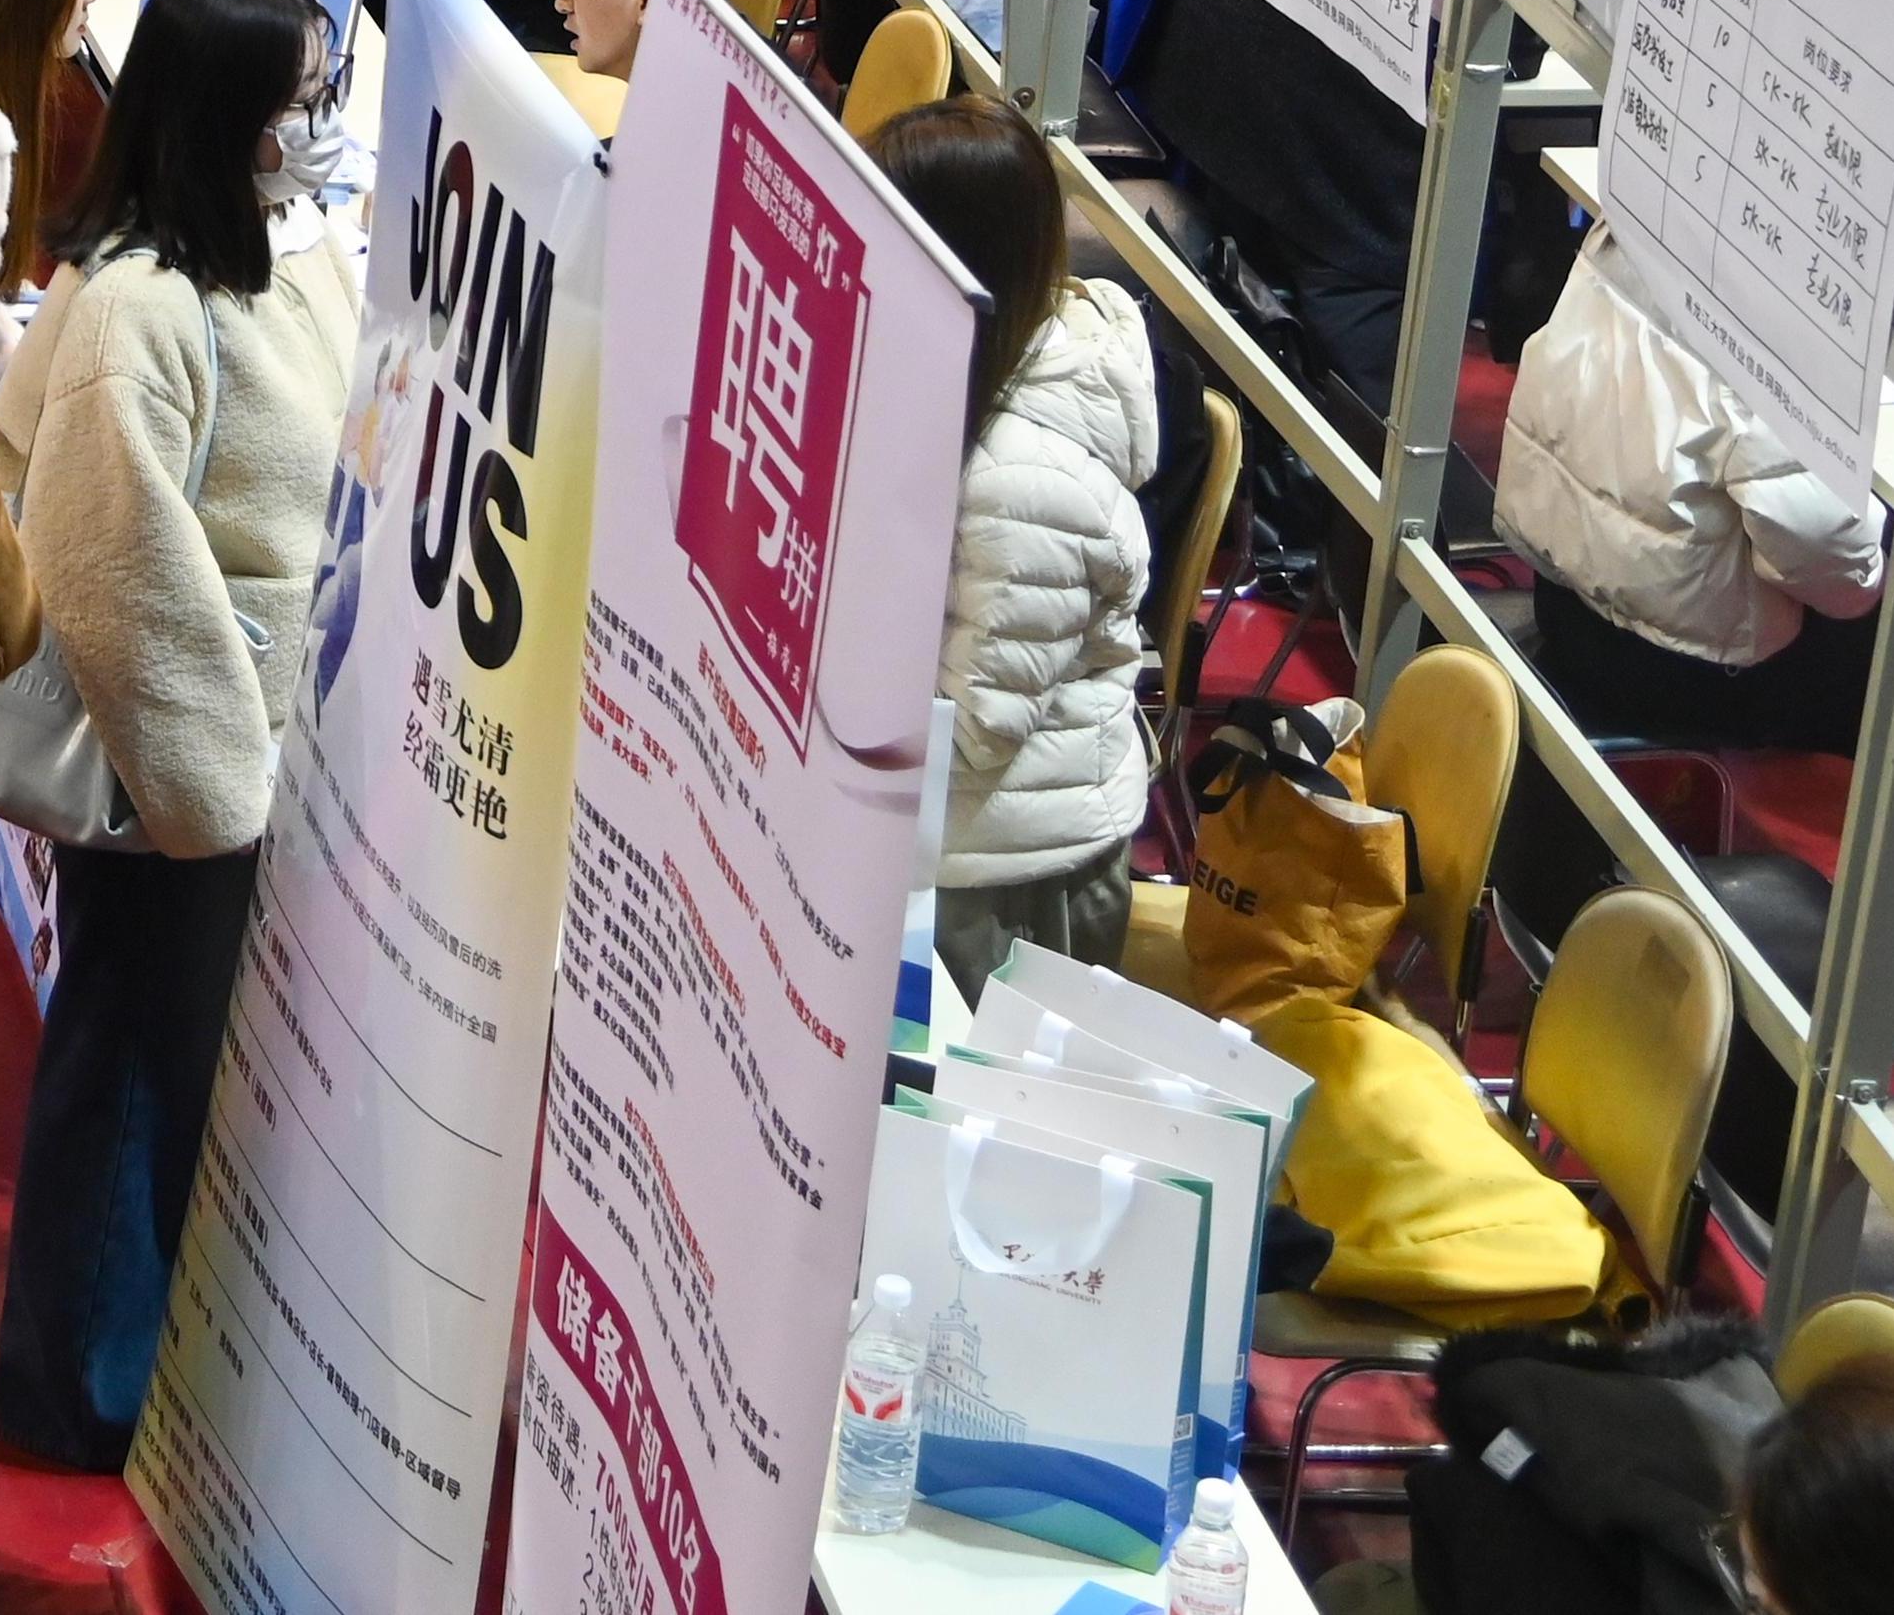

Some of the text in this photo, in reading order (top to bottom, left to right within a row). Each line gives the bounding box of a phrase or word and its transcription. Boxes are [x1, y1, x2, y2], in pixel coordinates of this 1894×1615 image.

[1705, 80, 1718, 110] 5
[1801, 35, 1853, 97] 岗位要求
[745, 126, 815, 228] 如果你足够优秀
[1694, 154, 1705, 185] 5
[410, 105, 555, 459] JOIN
[710, 223, 816, 575] 聘
[410, 392, 530, 672] US
[780, 522, 818, 630] 拼
[402, 709, 508, 841] 经霜更艳
[411, 647, 515, 778] 遇雪尤清
[556, 1253, 702, 1615] 储备干部10名
